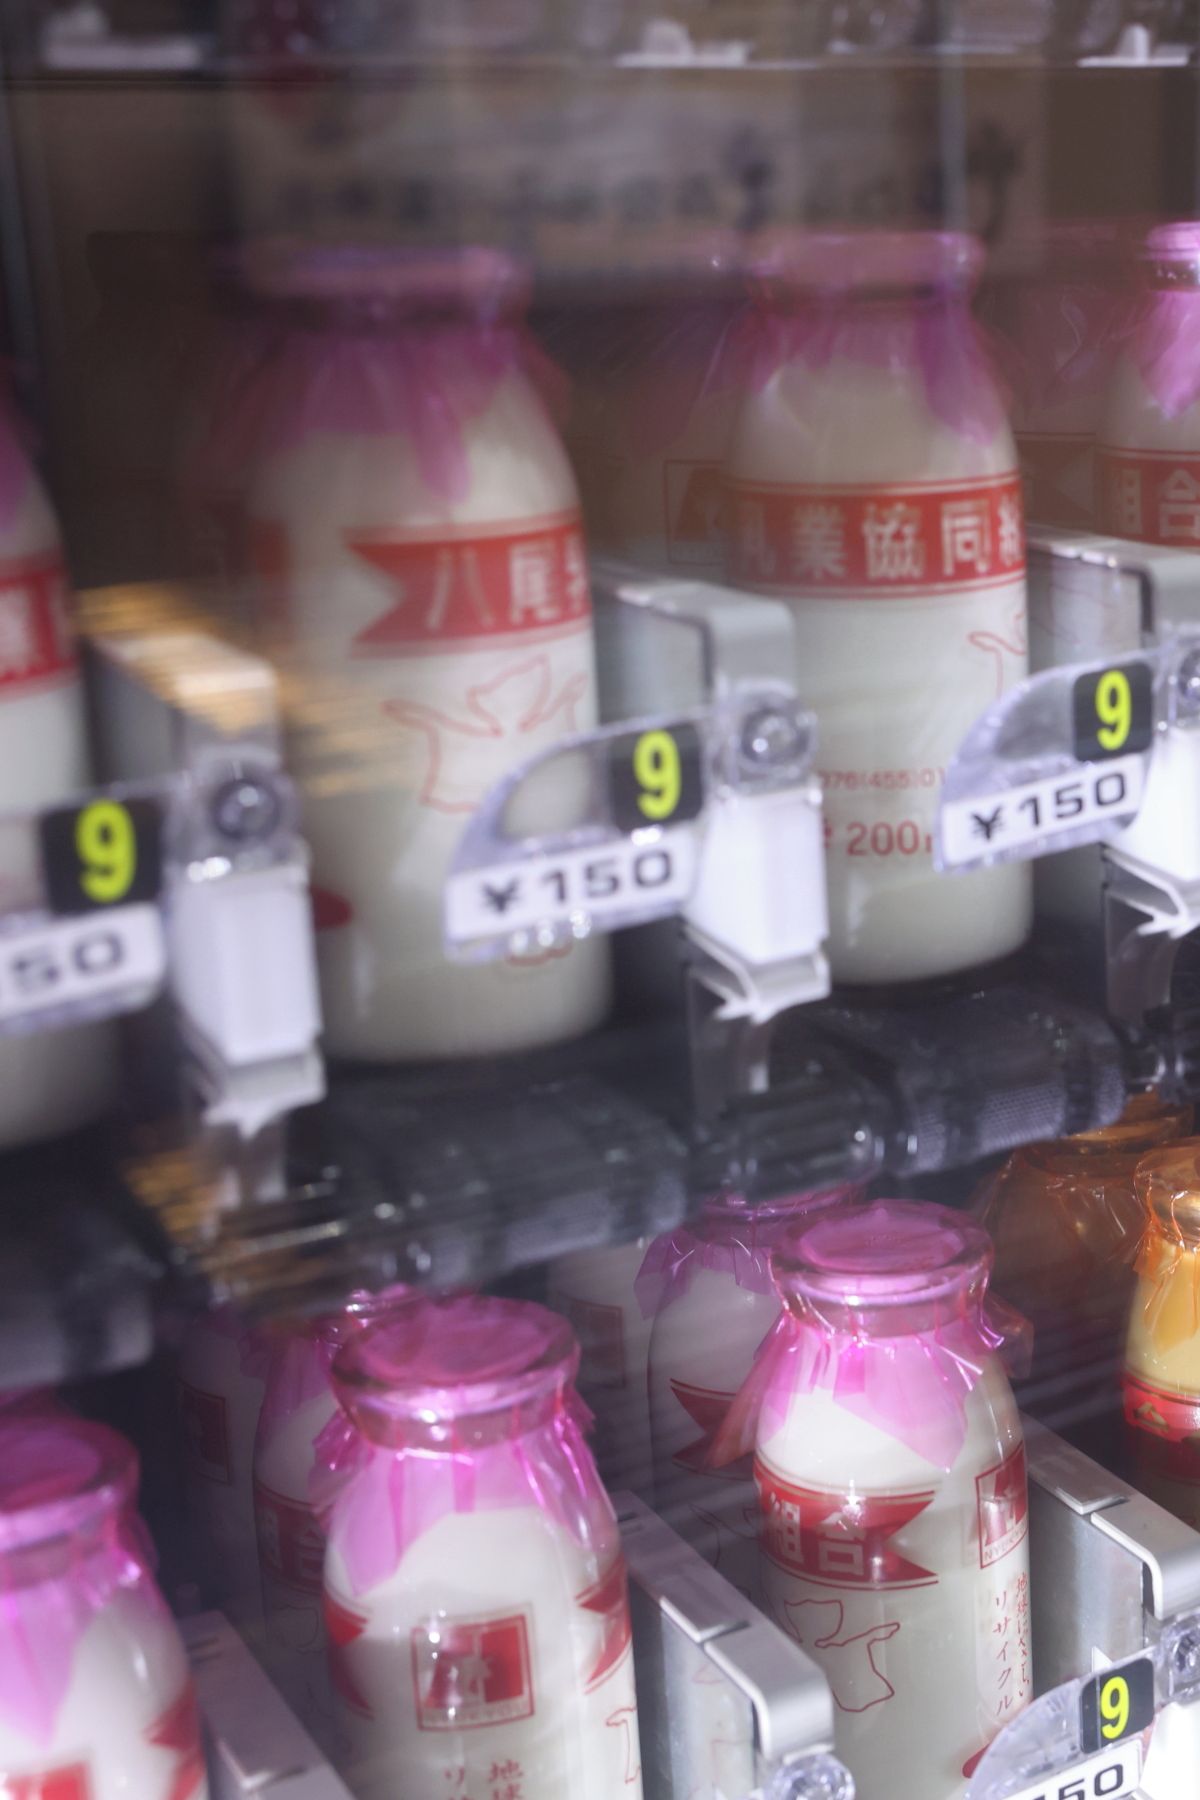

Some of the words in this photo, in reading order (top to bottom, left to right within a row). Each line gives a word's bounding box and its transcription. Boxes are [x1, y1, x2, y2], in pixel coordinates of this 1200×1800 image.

[1095, 669, 1132, 750] 9
[634, 729, 682, 821] 9
[970, 773, 1126, 840] ¥150
[76, 800, 137, 903] 9
[481, 848, 674, 914] ¥150
[992, 1591, 1013, 1717] リサイクル
[1100, 1676, 1130, 1740] 9
